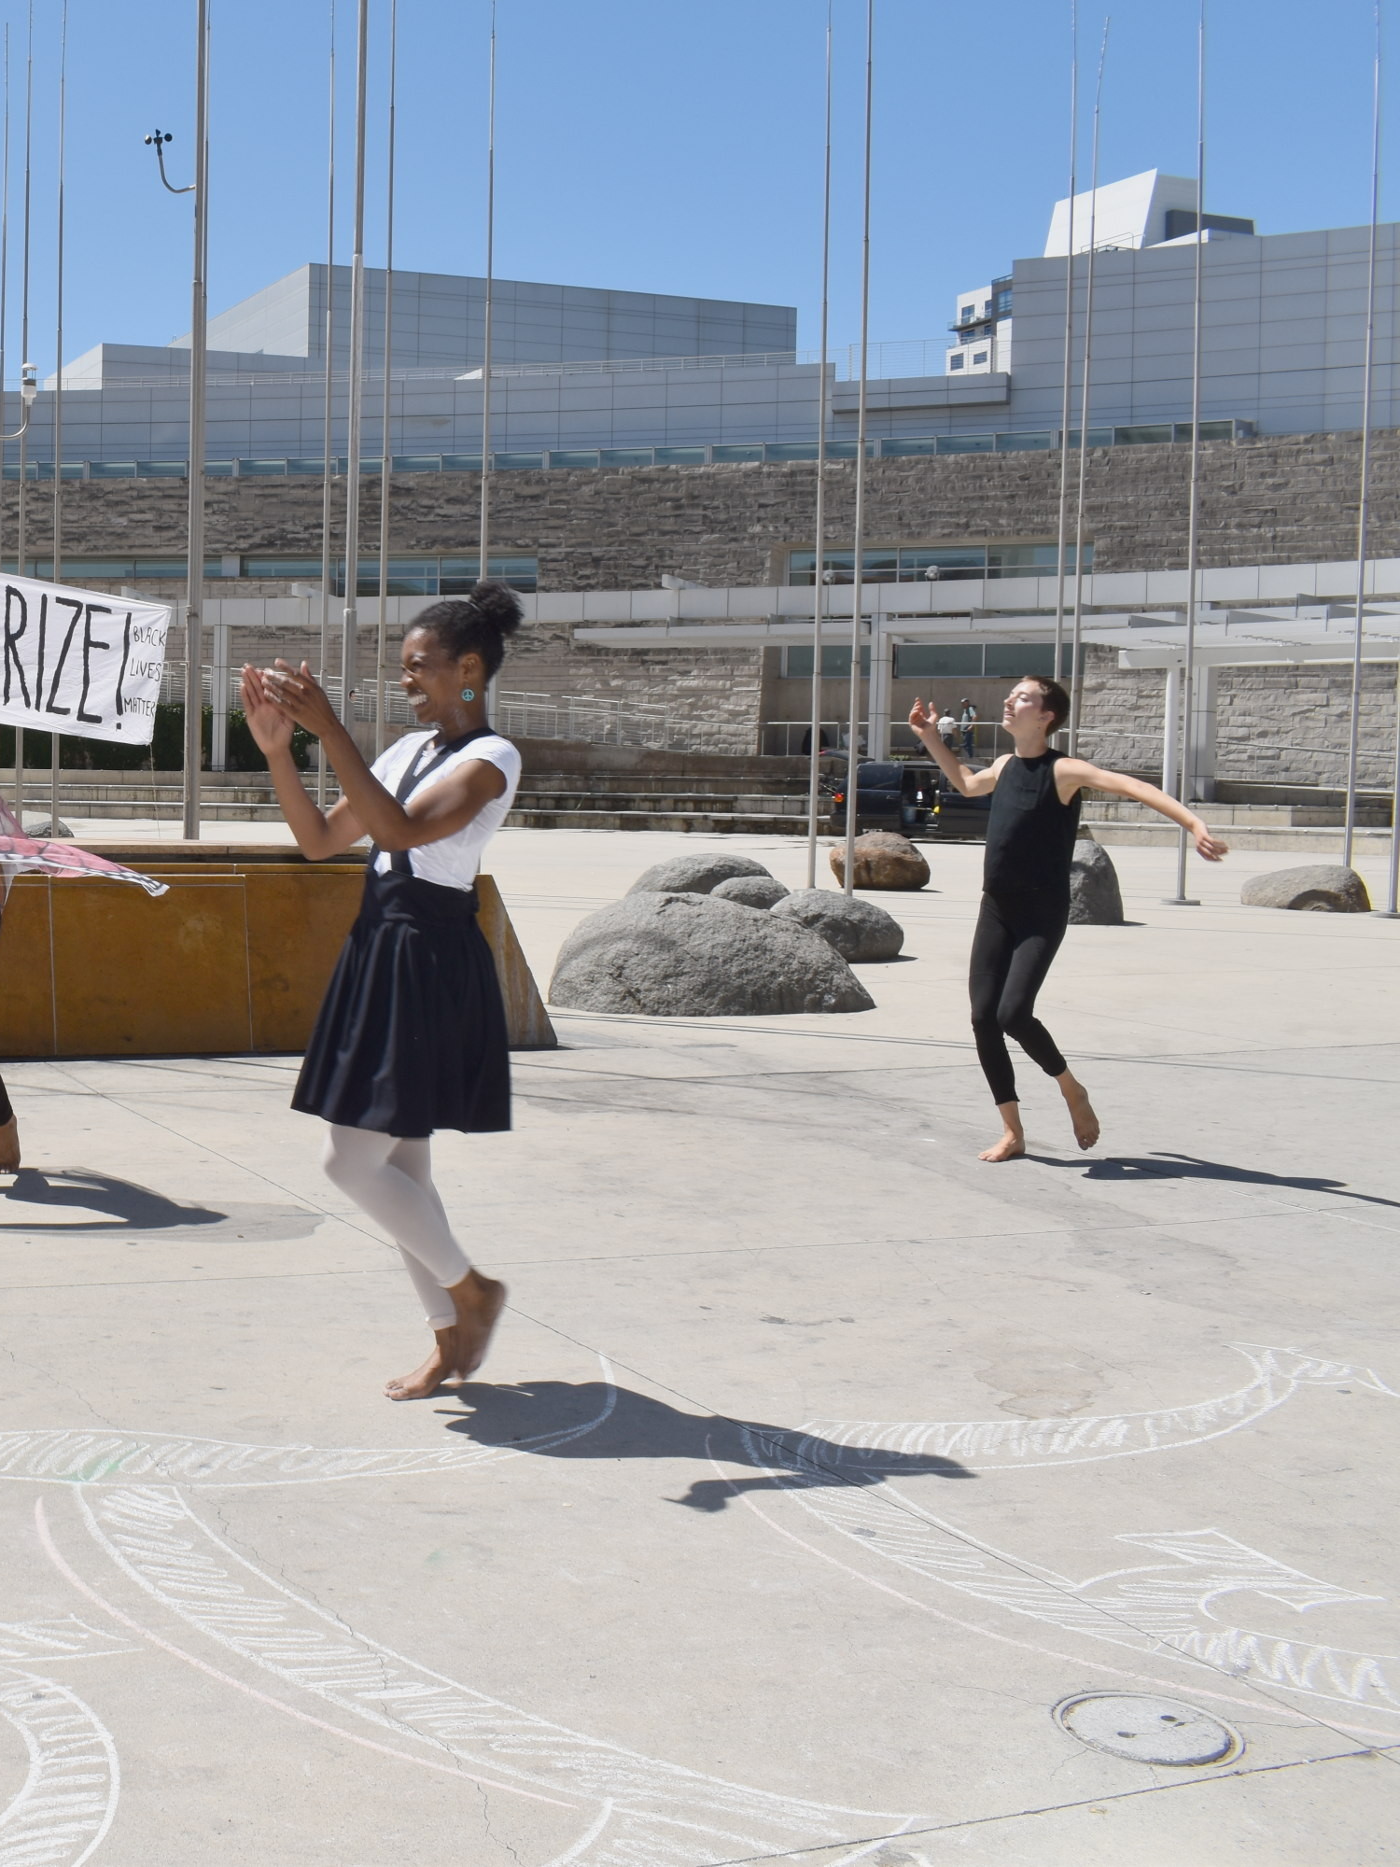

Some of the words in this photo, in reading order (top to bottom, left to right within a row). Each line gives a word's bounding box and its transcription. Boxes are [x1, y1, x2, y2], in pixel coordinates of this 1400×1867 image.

[132, 625, 167, 647] BLACK
[129, 657, 162, 682] LIVES
[123, 697, 156, 718] MATTER
